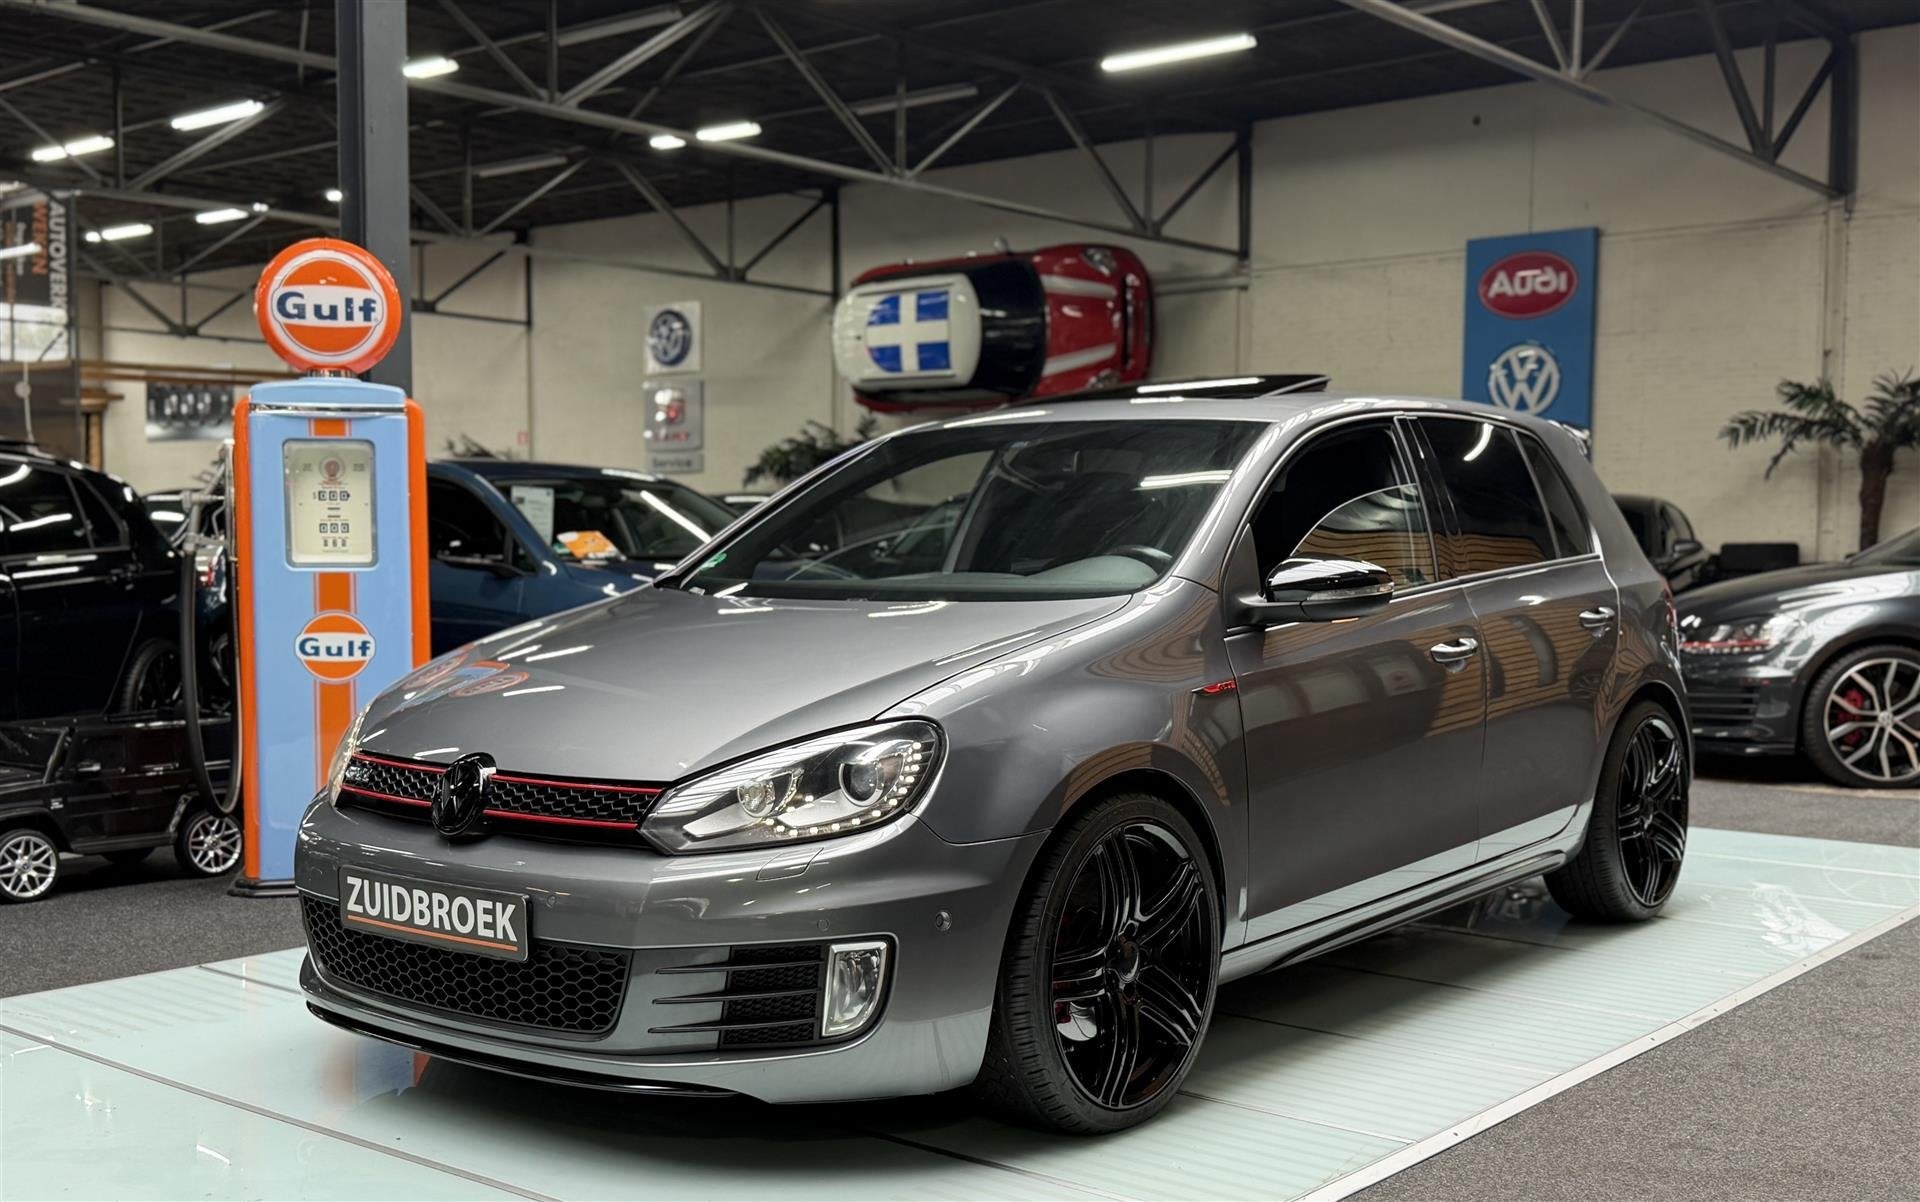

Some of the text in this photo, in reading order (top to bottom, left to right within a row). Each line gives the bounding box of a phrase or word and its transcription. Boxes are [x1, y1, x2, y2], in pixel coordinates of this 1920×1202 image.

[277, 291, 376, 322] Gulf
[299, 637, 371, 657] Gulf
[346, 876, 518, 942] ZUIDBROEK
